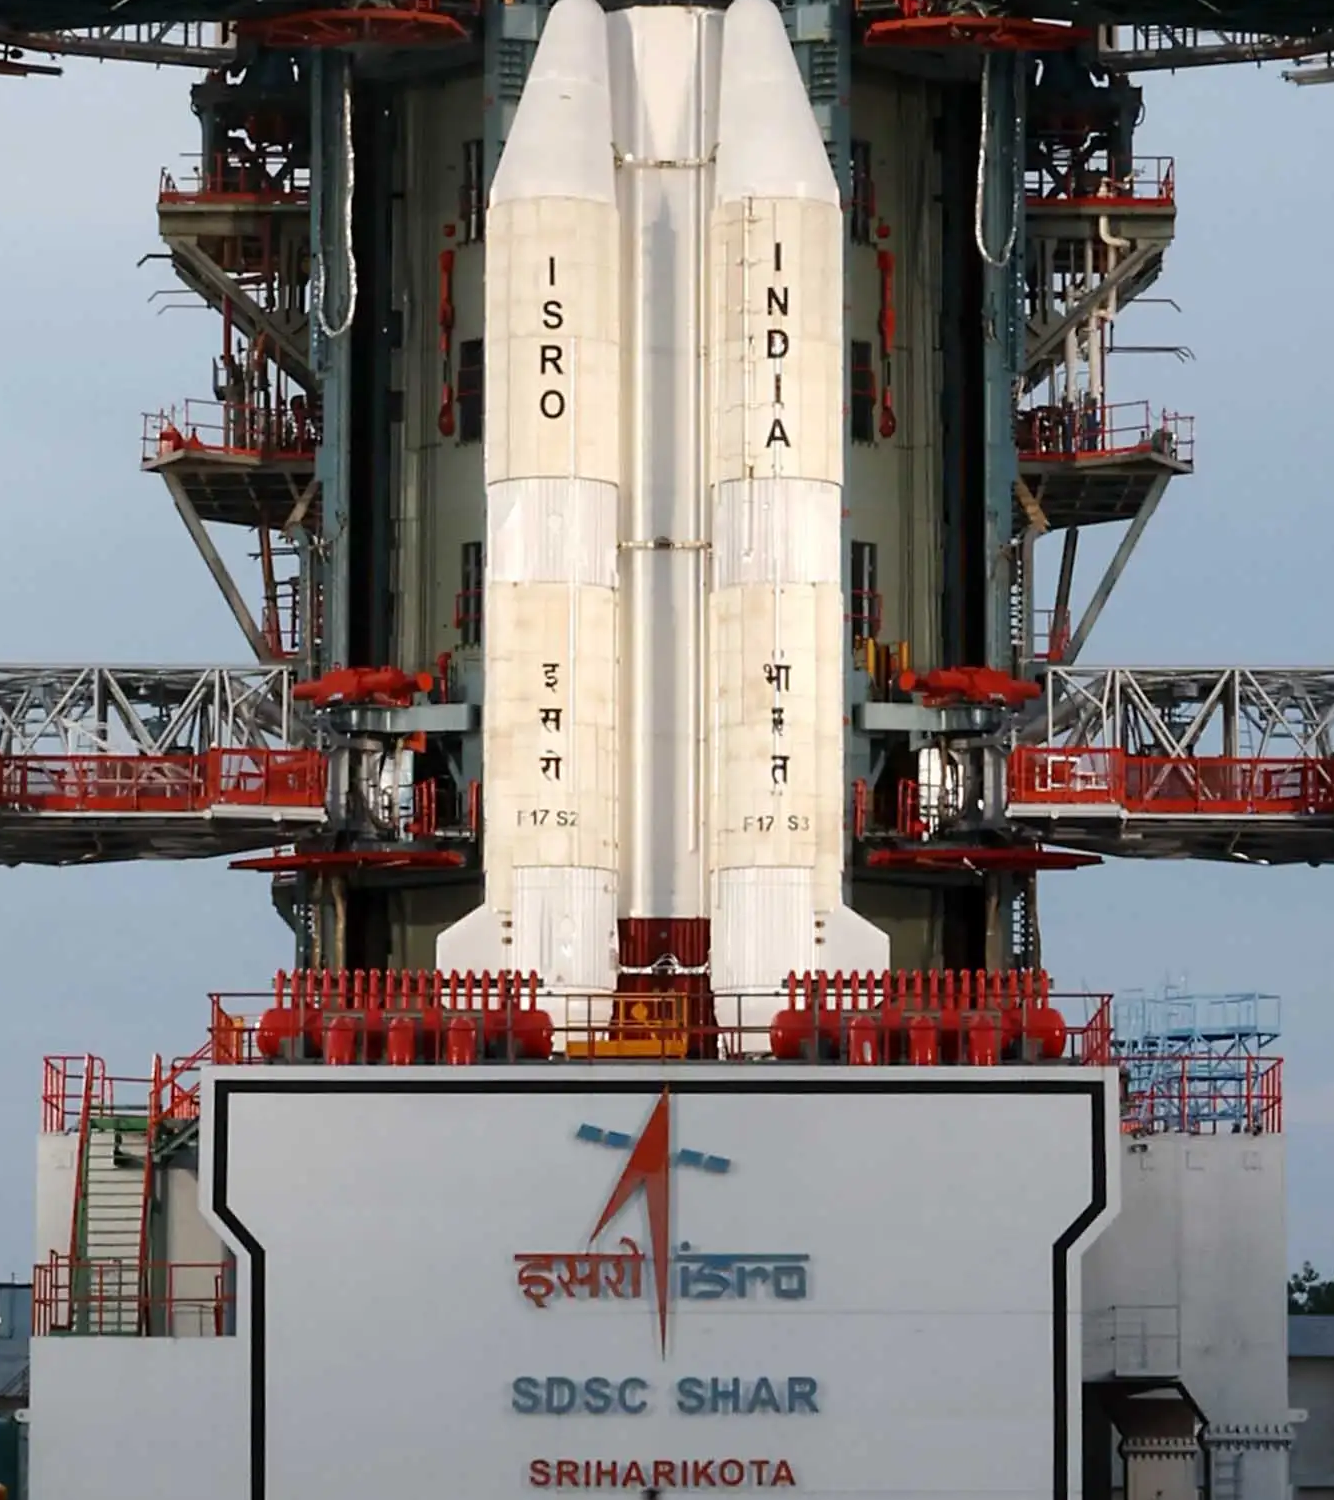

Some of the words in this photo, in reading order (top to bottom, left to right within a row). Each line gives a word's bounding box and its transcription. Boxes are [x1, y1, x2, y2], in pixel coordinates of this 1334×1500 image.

[539, 256, 565, 421] ISRO
[765, 242, 792, 448] INDIA
[539, 663, 563, 782] इसरो
[556, 811, 580, 827] S2
[744, 815, 775, 832] F17
[788, 815, 810, 831] S3
[514, 1237, 645, 1308] इसरो
[677, 1241, 810, 1299] isro
[512, 1376, 649, 1415] SDSC
[677, 1376, 820, 1415] SHAR
[529, 1458, 796, 1488] SRIHARIKOTA
